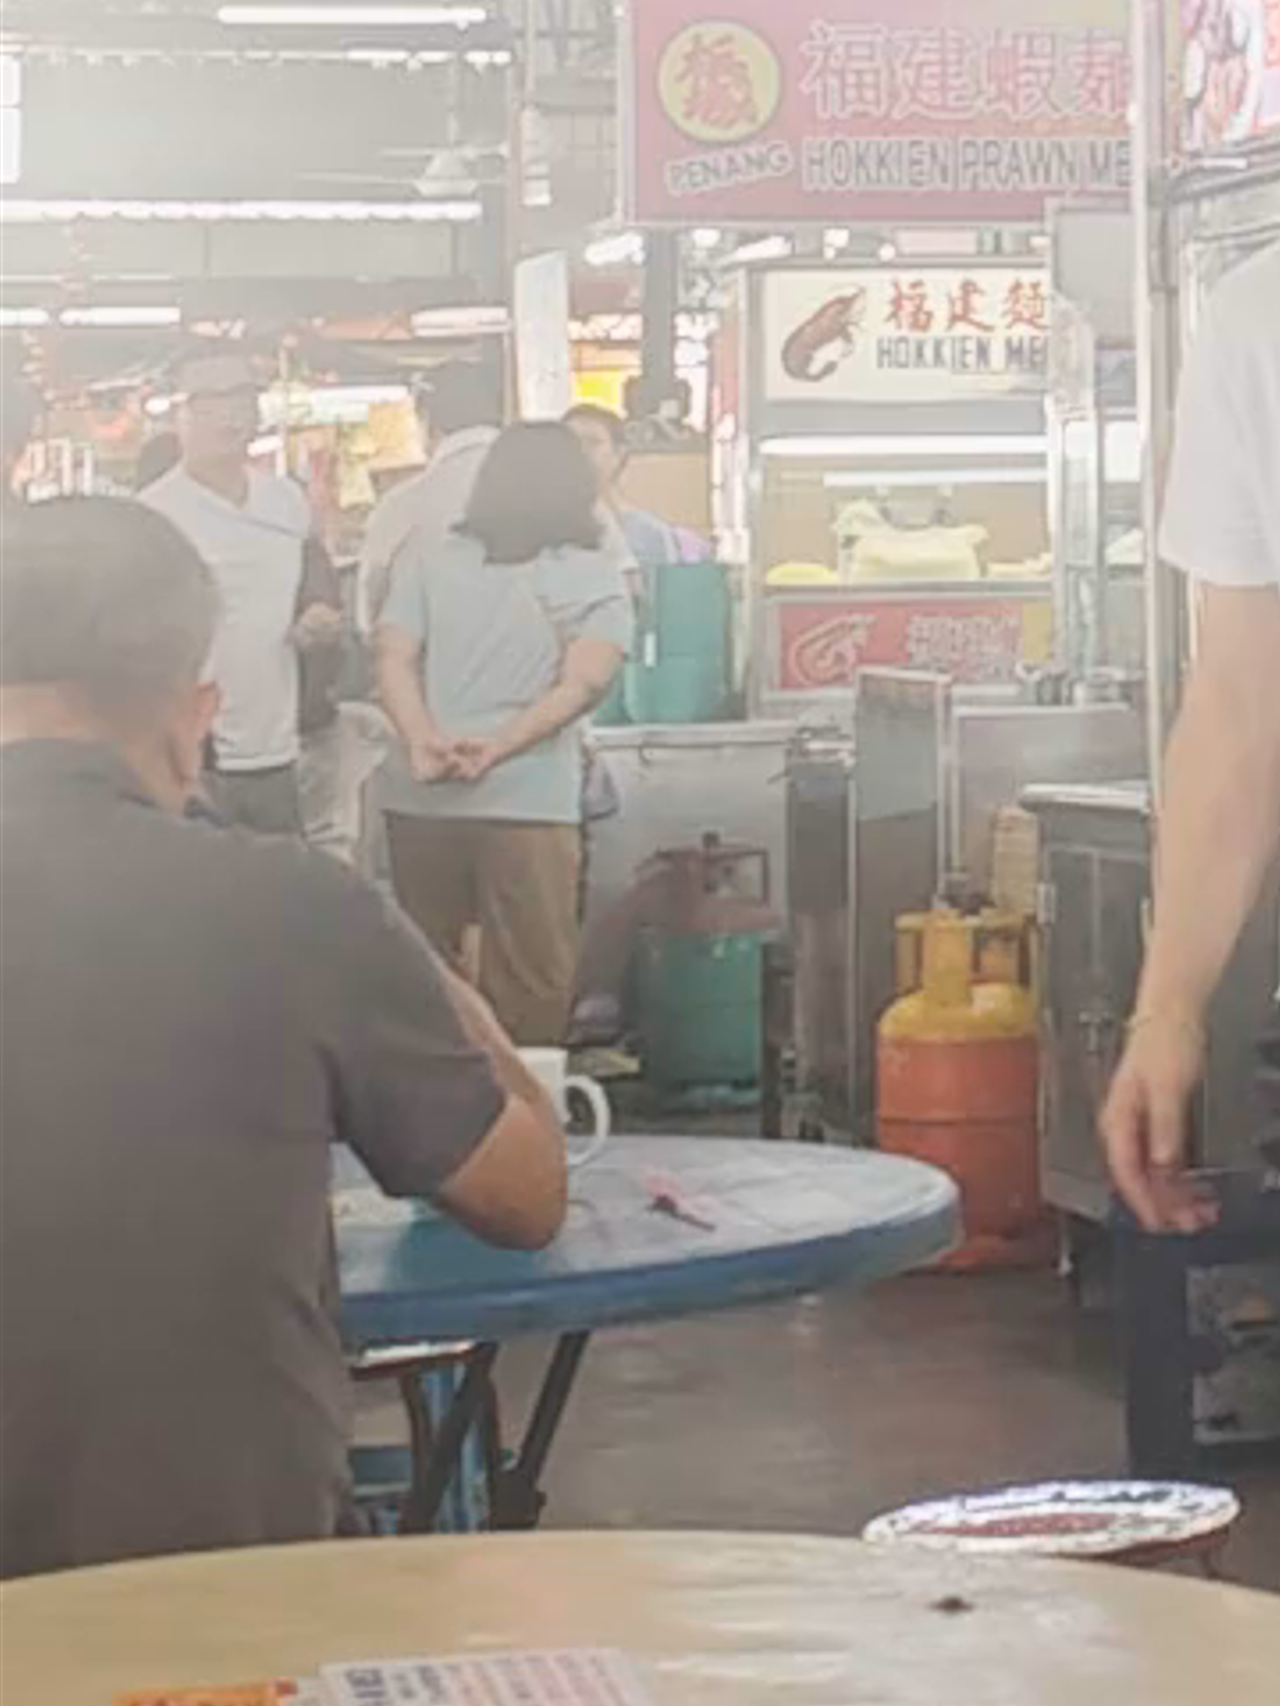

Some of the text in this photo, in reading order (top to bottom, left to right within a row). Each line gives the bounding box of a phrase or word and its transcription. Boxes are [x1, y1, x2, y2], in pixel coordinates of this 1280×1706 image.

[663, 141, 794, 197] PENANG
[803, 136, 955, 190] HOKKIEN
[957, 137, 1083, 192] PRAWN
[876, 336, 991, 371] HOKKIEN
